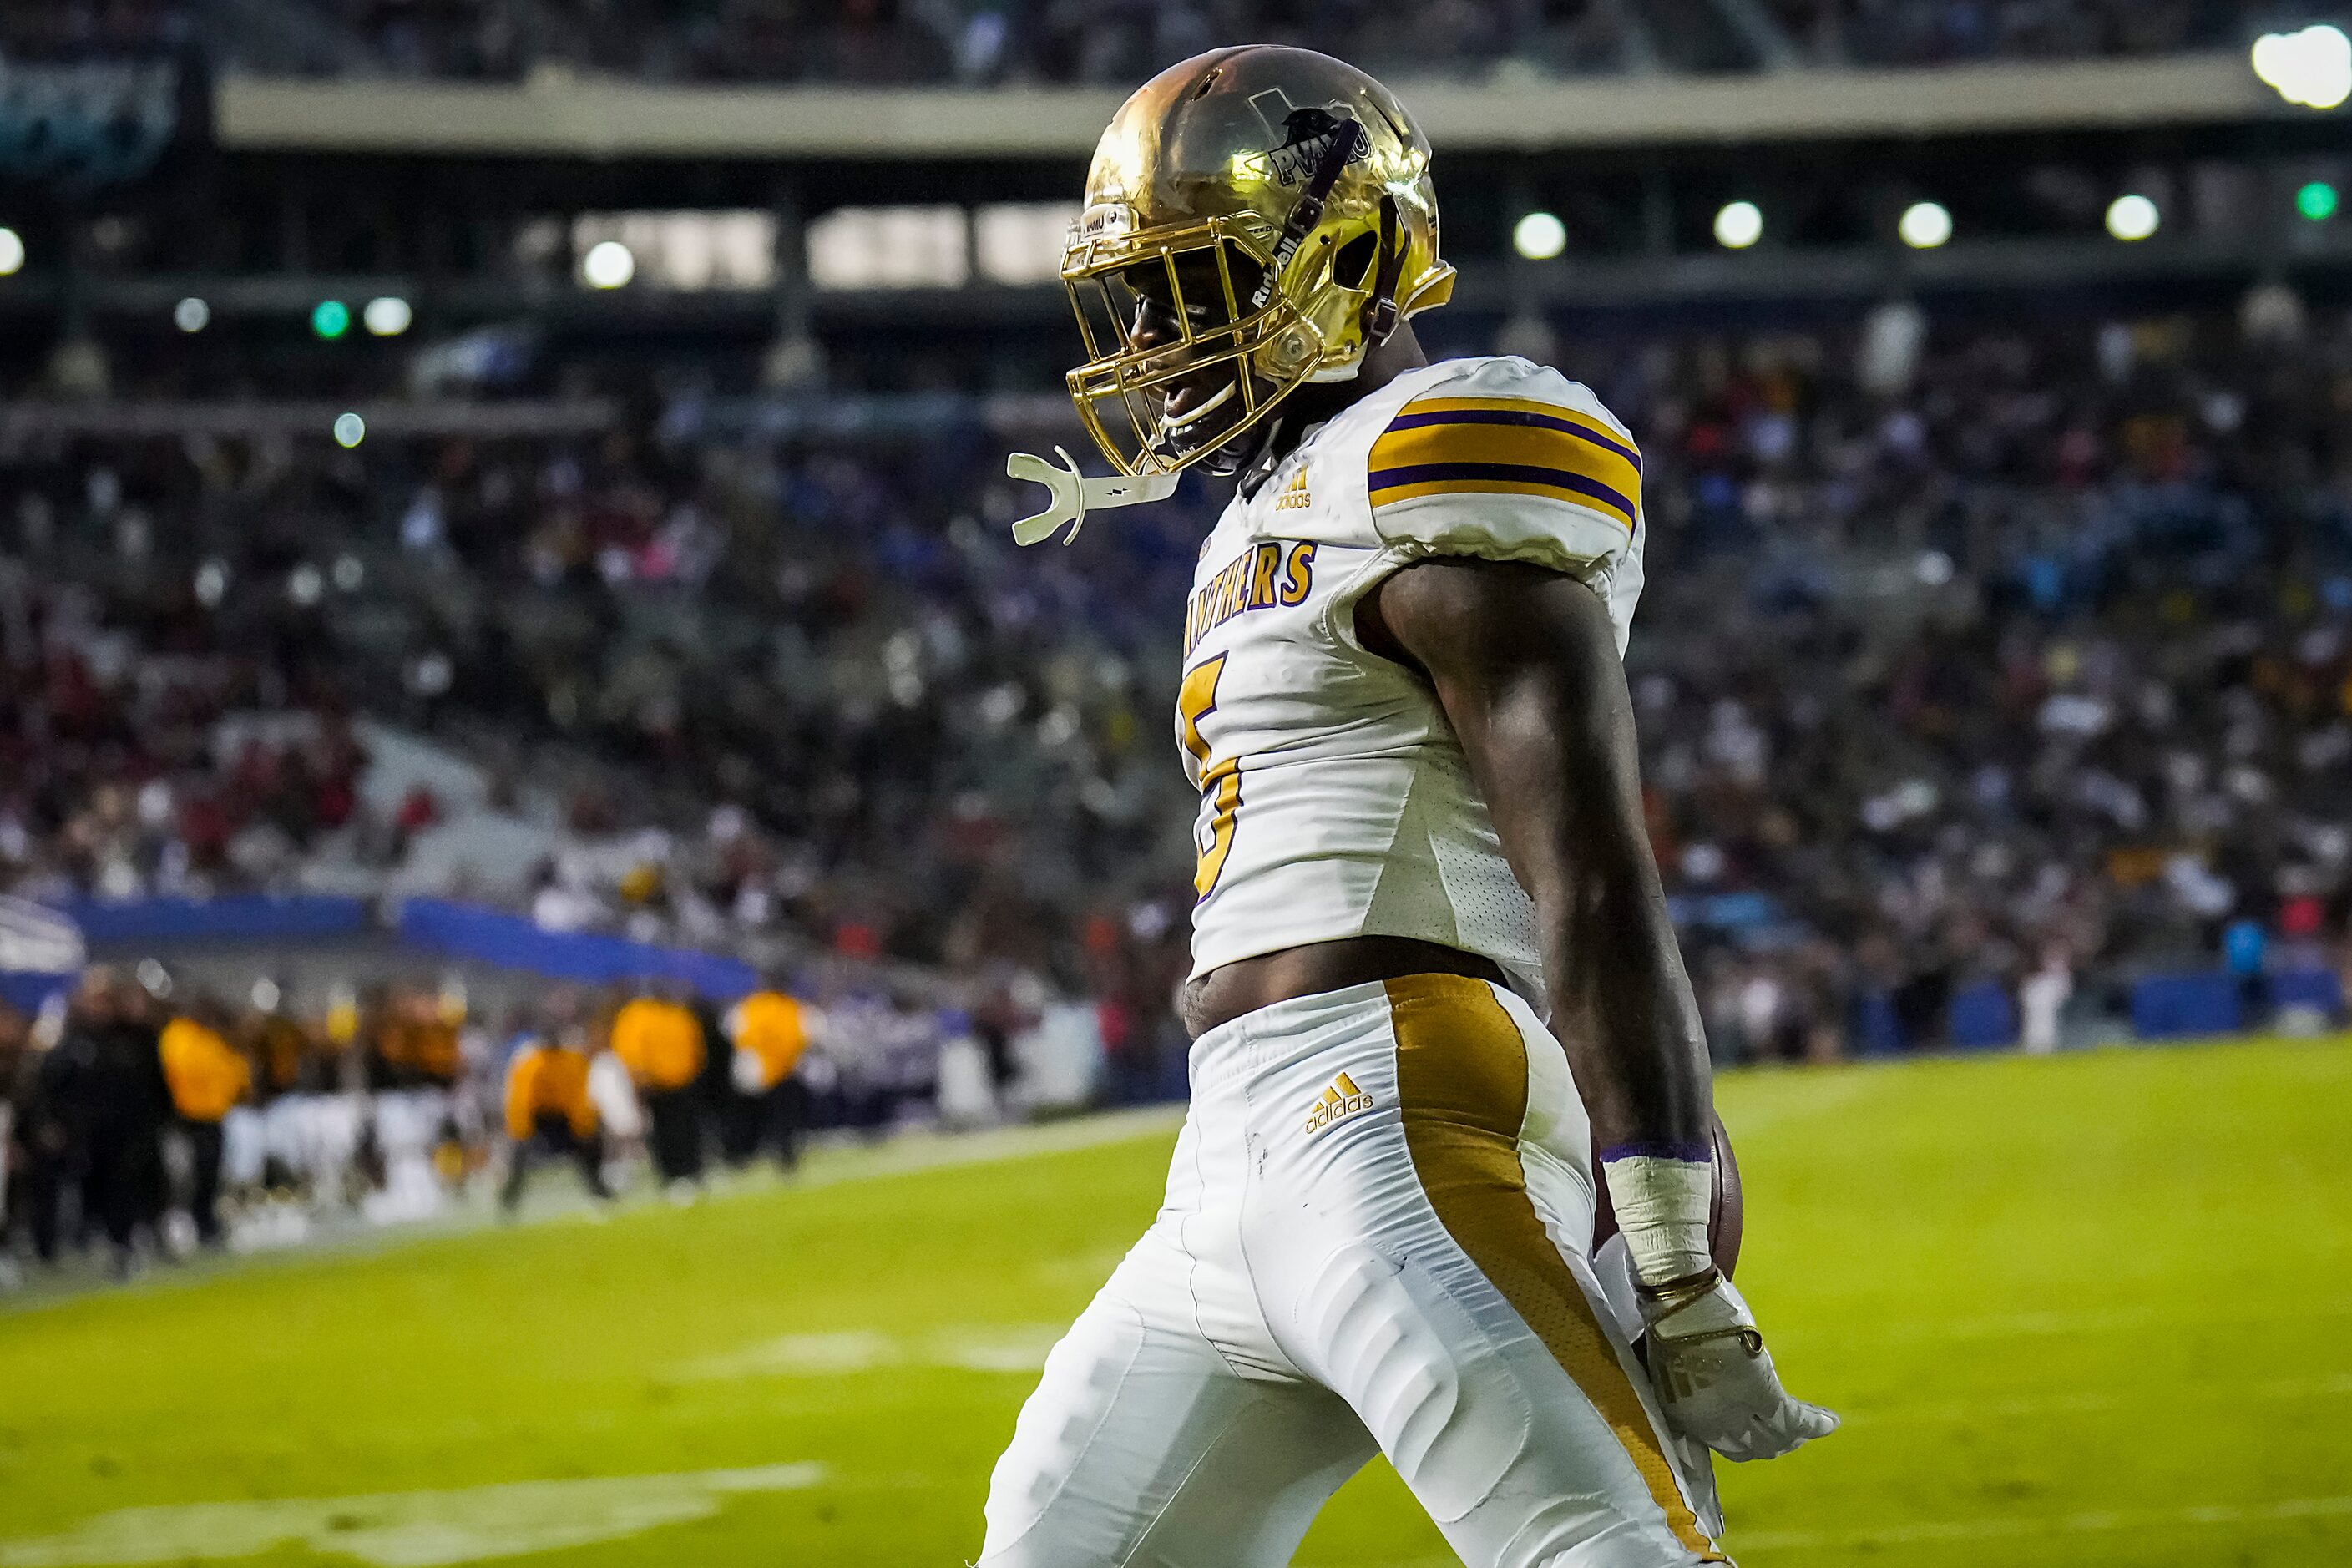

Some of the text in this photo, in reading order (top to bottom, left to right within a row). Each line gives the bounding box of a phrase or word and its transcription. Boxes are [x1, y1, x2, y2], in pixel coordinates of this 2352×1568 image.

[1184, 540, 1318, 665] ANTHERS
[1179, 650, 1244, 907] 5
[1305, 1095, 1374, 1135] adidas
